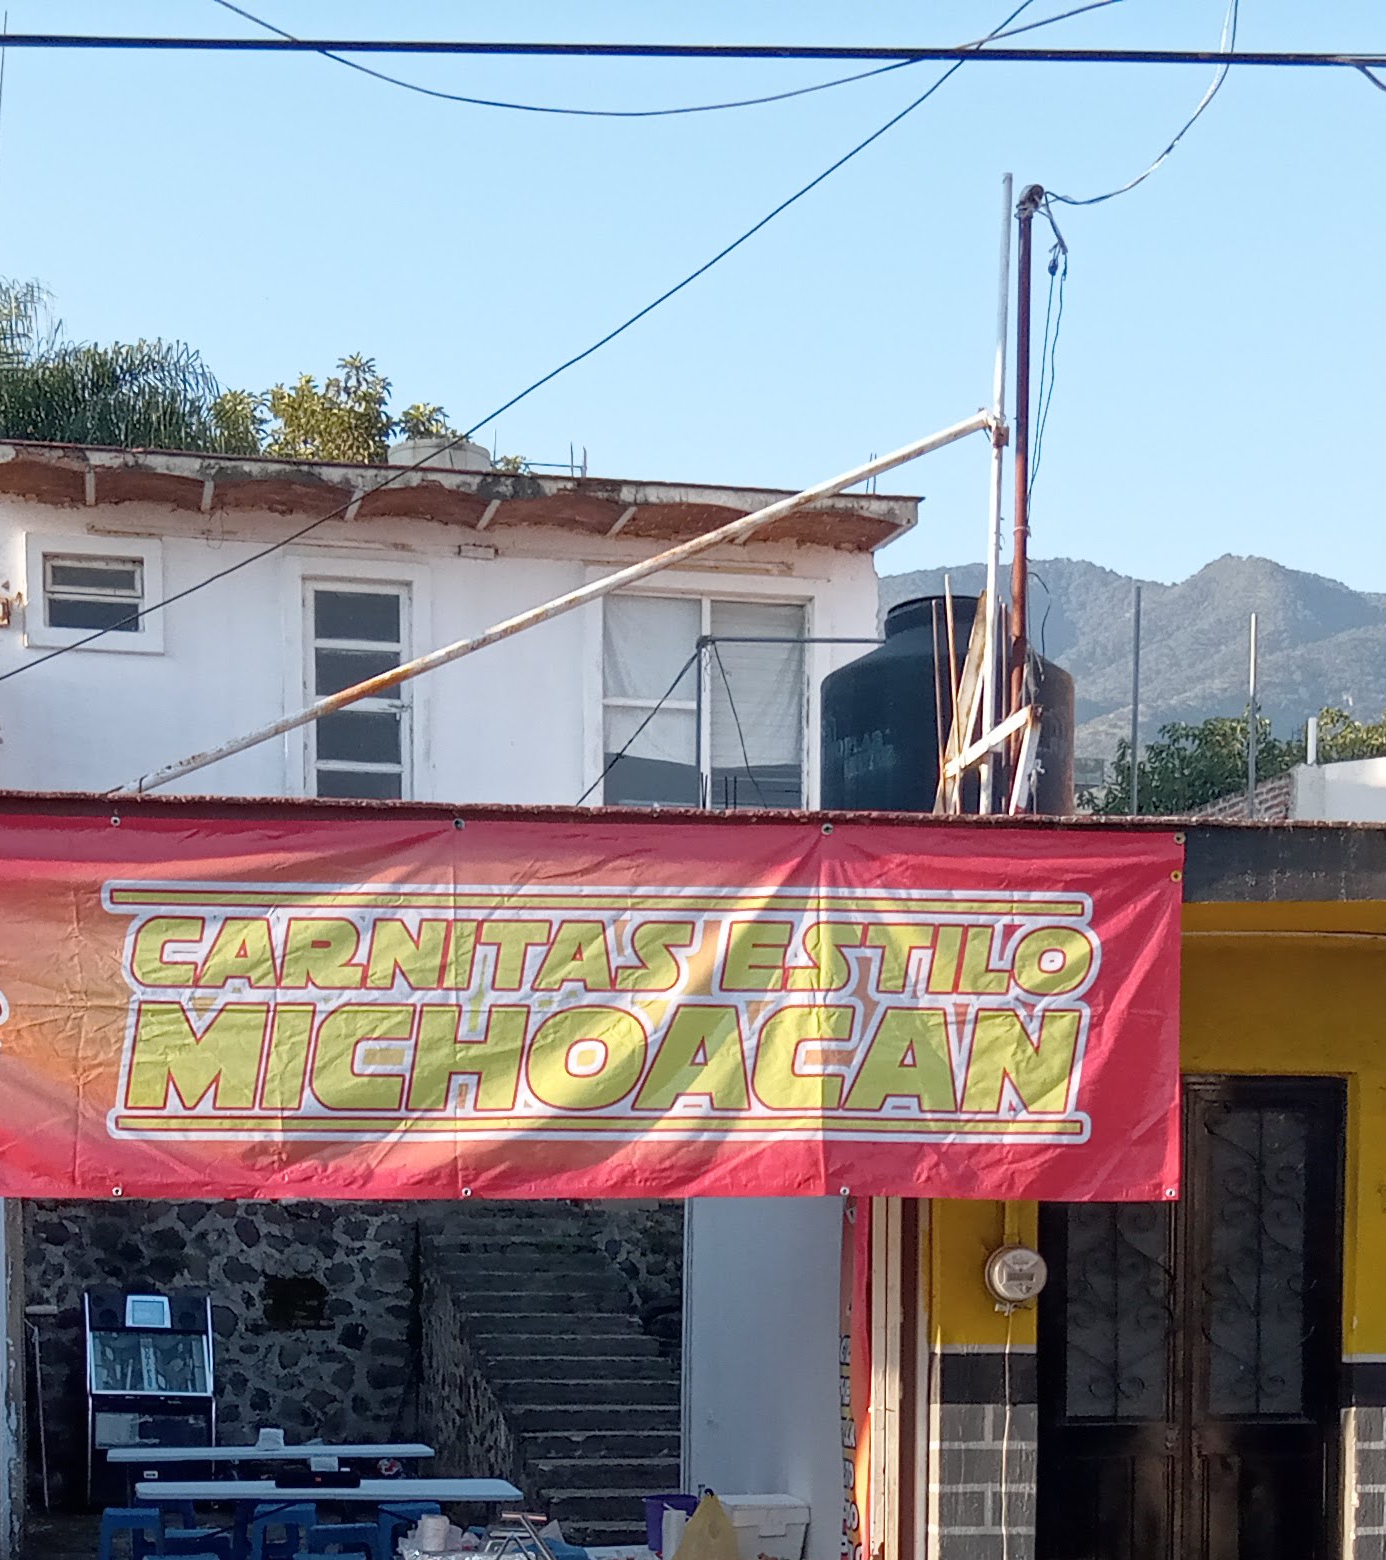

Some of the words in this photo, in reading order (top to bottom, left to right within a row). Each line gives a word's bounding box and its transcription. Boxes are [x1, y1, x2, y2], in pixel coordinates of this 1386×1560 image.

[130, 916, 696, 992] CARNITAS
[719, 920, 1075, 996] ESTILO
[124, 1001, 1083, 1114] MICHOACAN
